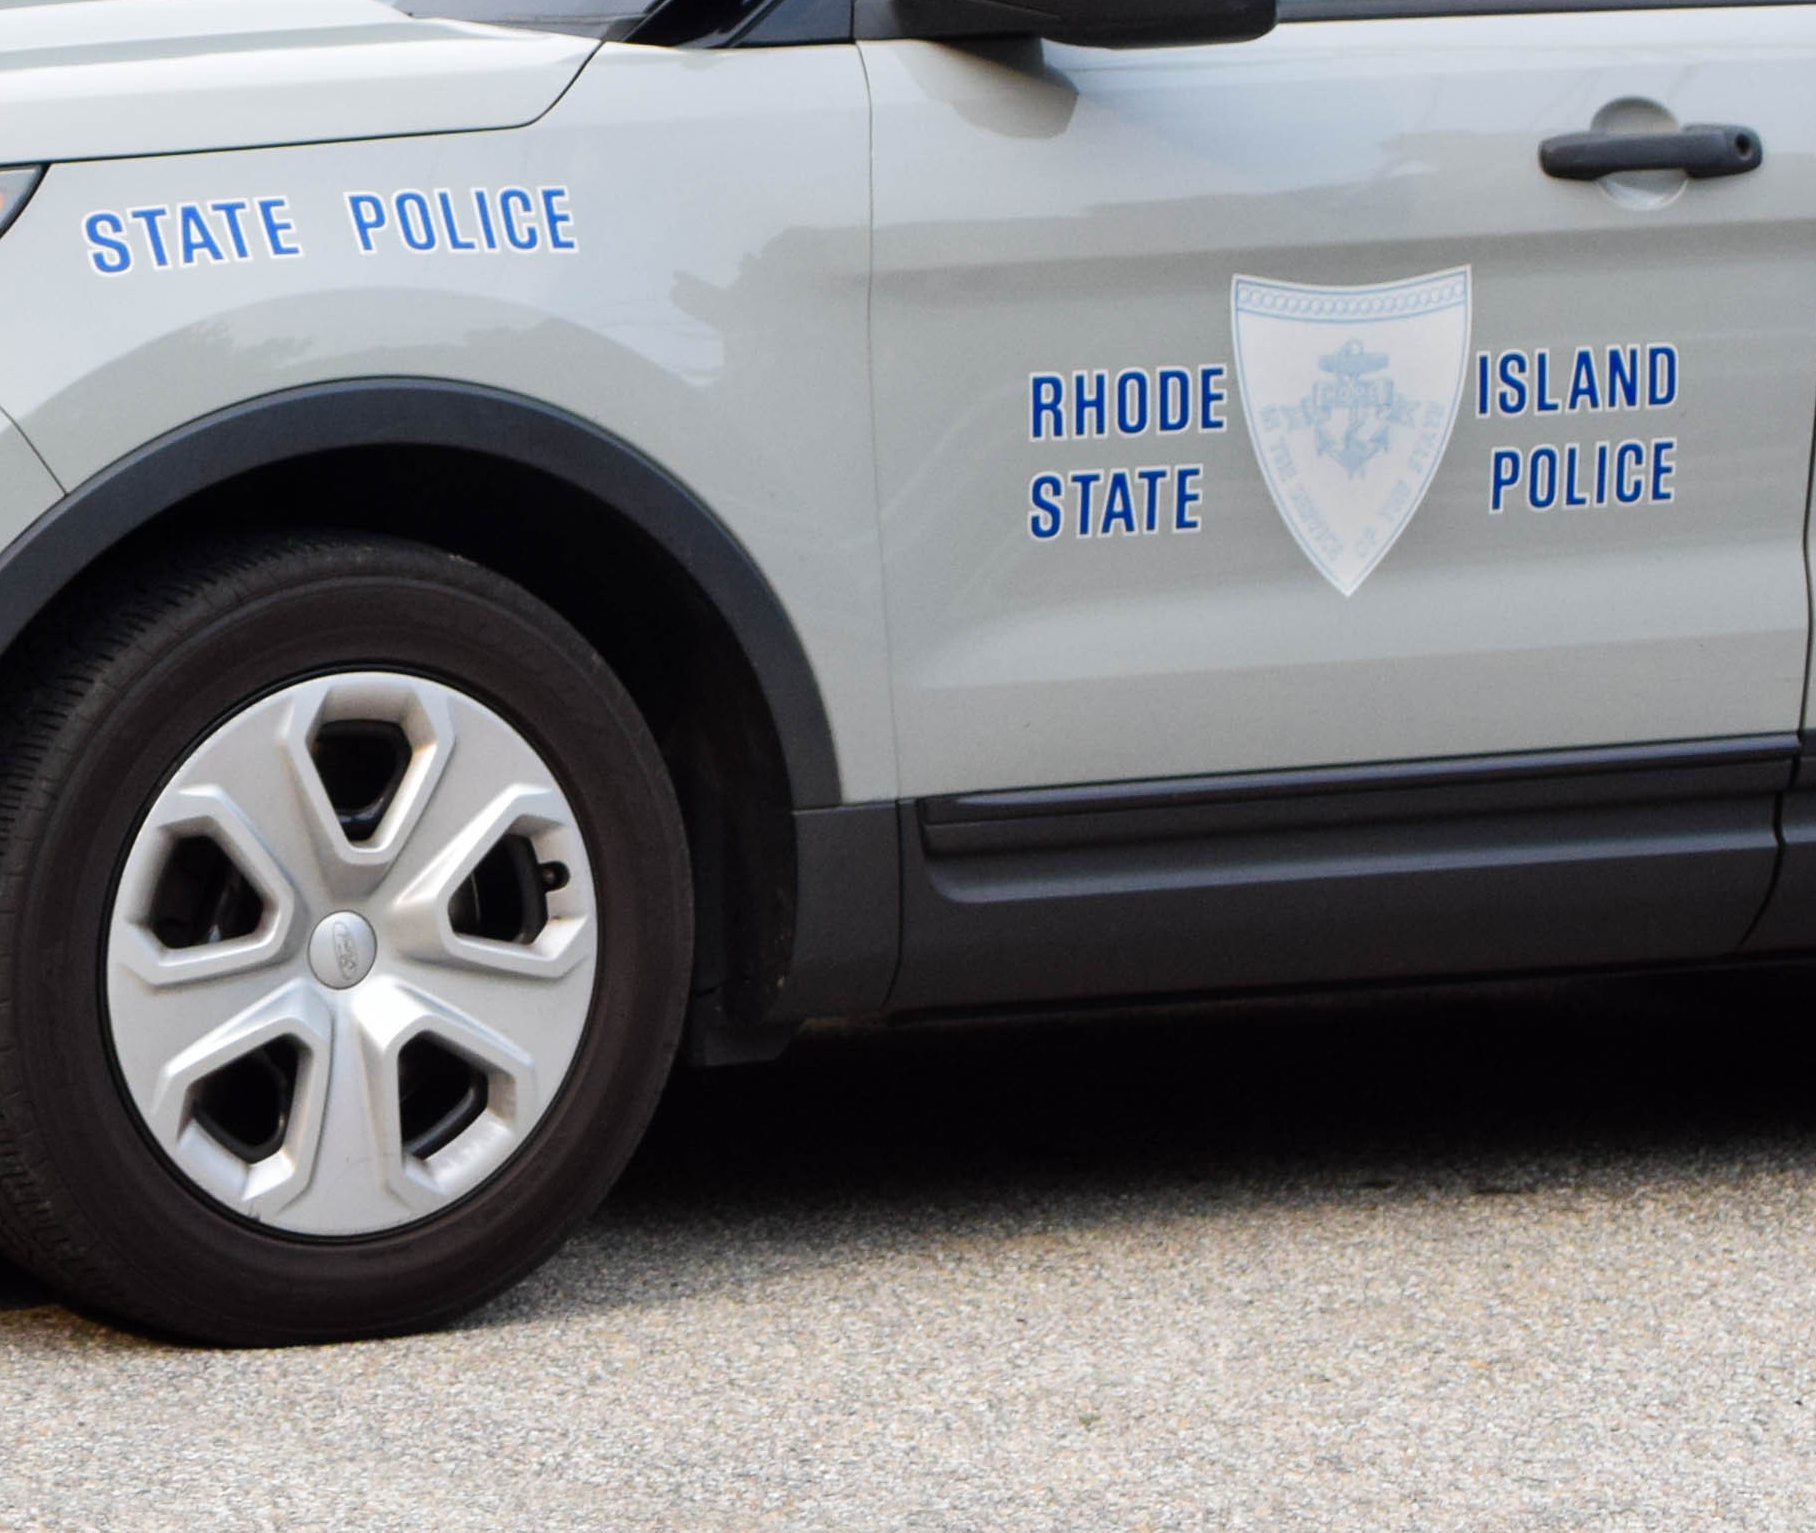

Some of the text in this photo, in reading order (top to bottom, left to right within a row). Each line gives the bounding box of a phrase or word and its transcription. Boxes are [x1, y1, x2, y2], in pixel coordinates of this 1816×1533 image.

[85, 187, 577, 275] STATE POLICE
[1030, 366, 1226, 439] RHODE
[1477, 344, 1679, 415] ISLAND
[1029, 466, 1203, 541] STATE
[1490, 439, 1676, 512] POLICE
